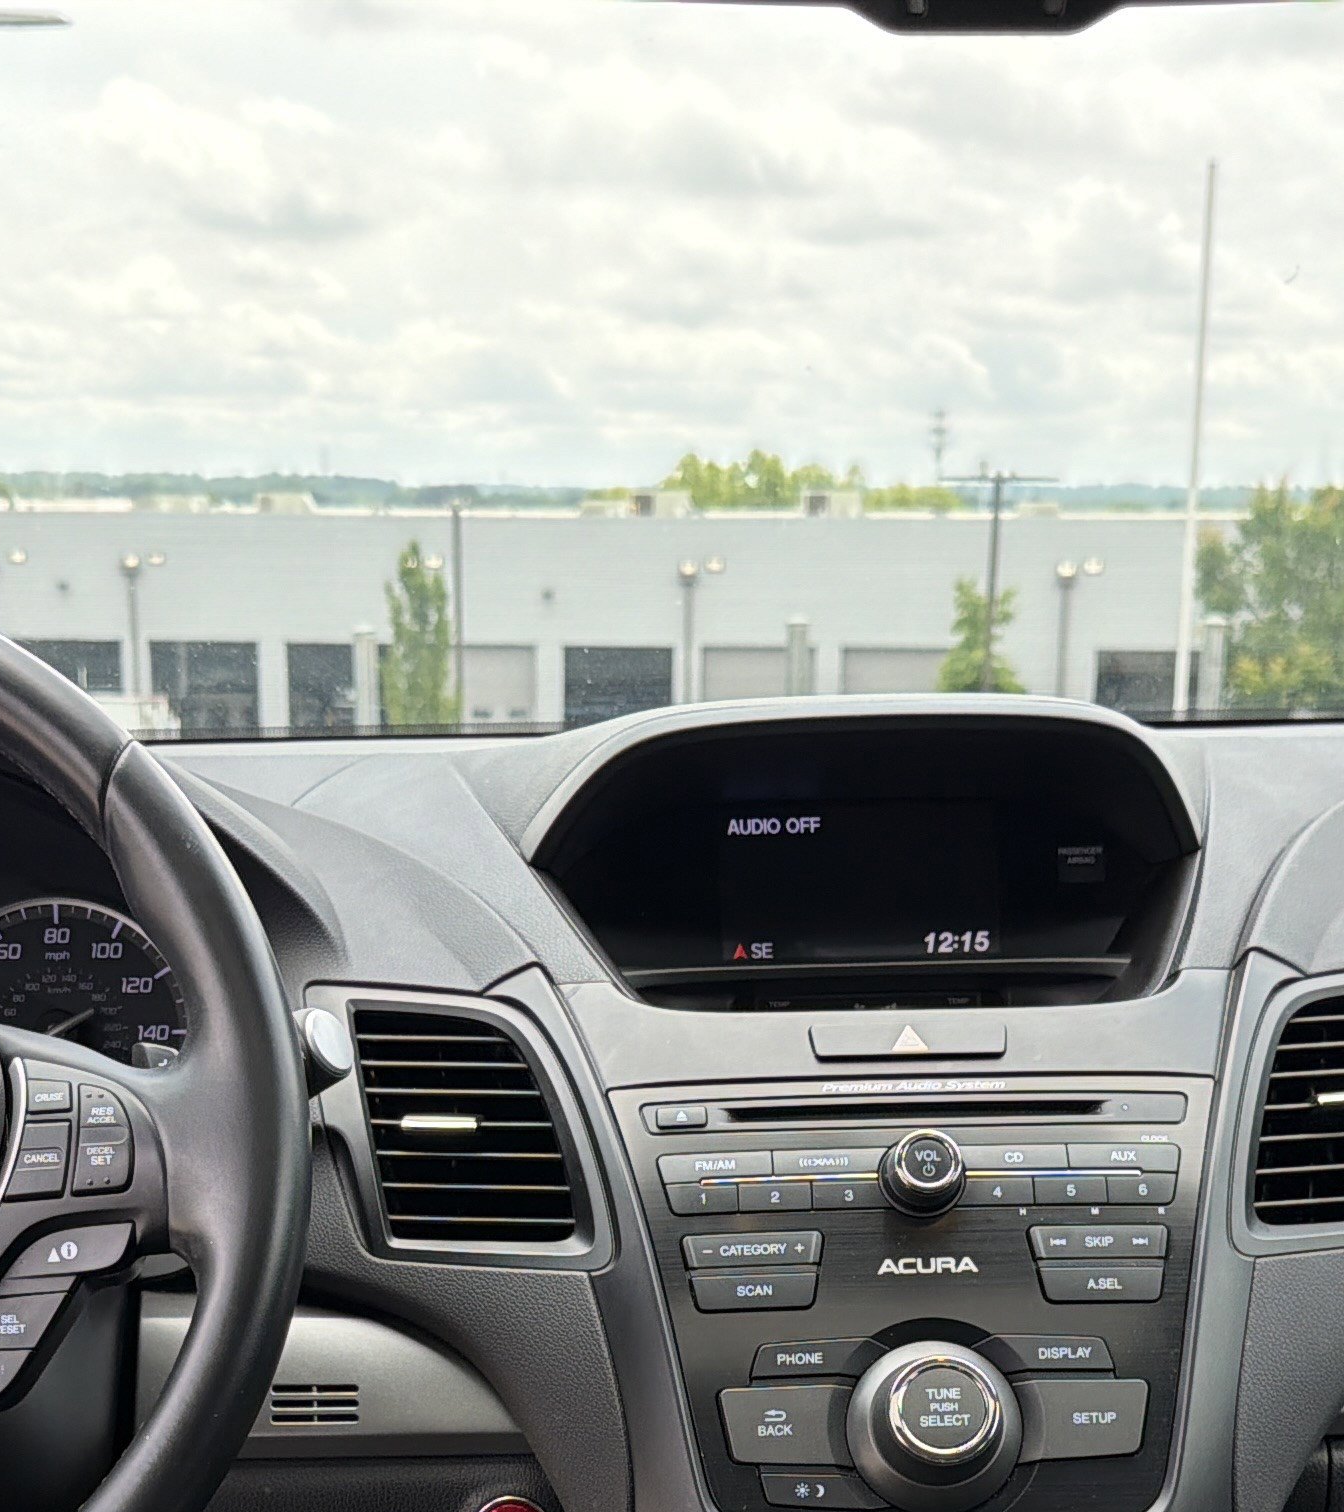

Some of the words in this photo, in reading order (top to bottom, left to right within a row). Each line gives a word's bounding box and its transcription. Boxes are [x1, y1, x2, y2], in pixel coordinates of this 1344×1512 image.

[727, 817, 781, 836] AUDIO
[786, 816, 821, 835] OFF
[43, 927, 71, 944] 80
[923, 931, 990, 953] 12:15
[44, 951, 71, 961] mph
[91, 942, 123, 959] 100
[750, 942, 774, 960] SE
[41, 974, 57, 983] 120
[121, 977, 153, 994] 120
[137, 1024, 169, 1041] 140
[822, 1081, 892, 1093] Premium
[896, 1080, 941, 1092] Audio
[945, 1079, 1006, 1091] System
[34, 1092, 64, 1103] CRUISE
[90, 1106, 115, 1117] RES
[87, 1115, 117, 1124] ACCEL
[86, 1146, 115, 1155] DECEL
[914, 1149, 942, 1161] VOL
[1004, 1151, 1024, 1163] CD
[1110, 1150, 1137, 1162] AUX
[23, 1152, 60, 1164] CANCEL
[90, 1155, 113, 1166] SET
[694, 1159, 736, 1172] FM/AM
[844, 1189, 854, 1202] 3
[992, 1186, 1003, 1198] 4
[1066, 1184, 1077, 1197] 5
[1138, 1183, 1148, 1196] 6
[699, 1192, 708, 1205] 1
[770, 1191, 781, 1204] 2
[1018, 1207, 1027, 1216] H
[1090, 1207, 1100, 1215] M
[1084, 1236, 1114, 1248] SKIP
[719, 1242, 787, 1257] CATEGORY
[876, 1256, 979, 1275] ACURA
[1086, 1277, 1123, 1290] A.SEL
[736, 1285, 773, 1297] SCAN
[0, 1314, 19, 1324] SEL
[776, 1351, 824, 1366] PHONE
[1038, 1346, 1093, 1361] DISPLAY
[925, 1388, 961, 1400] TUNE
[929, 1401, 959, 1412] PUSH
[919, 1413, 971, 1428] SELECT
[1072, 1411, 1117, 1425] SETUP
[757, 1423, 793, 1437] BACK
